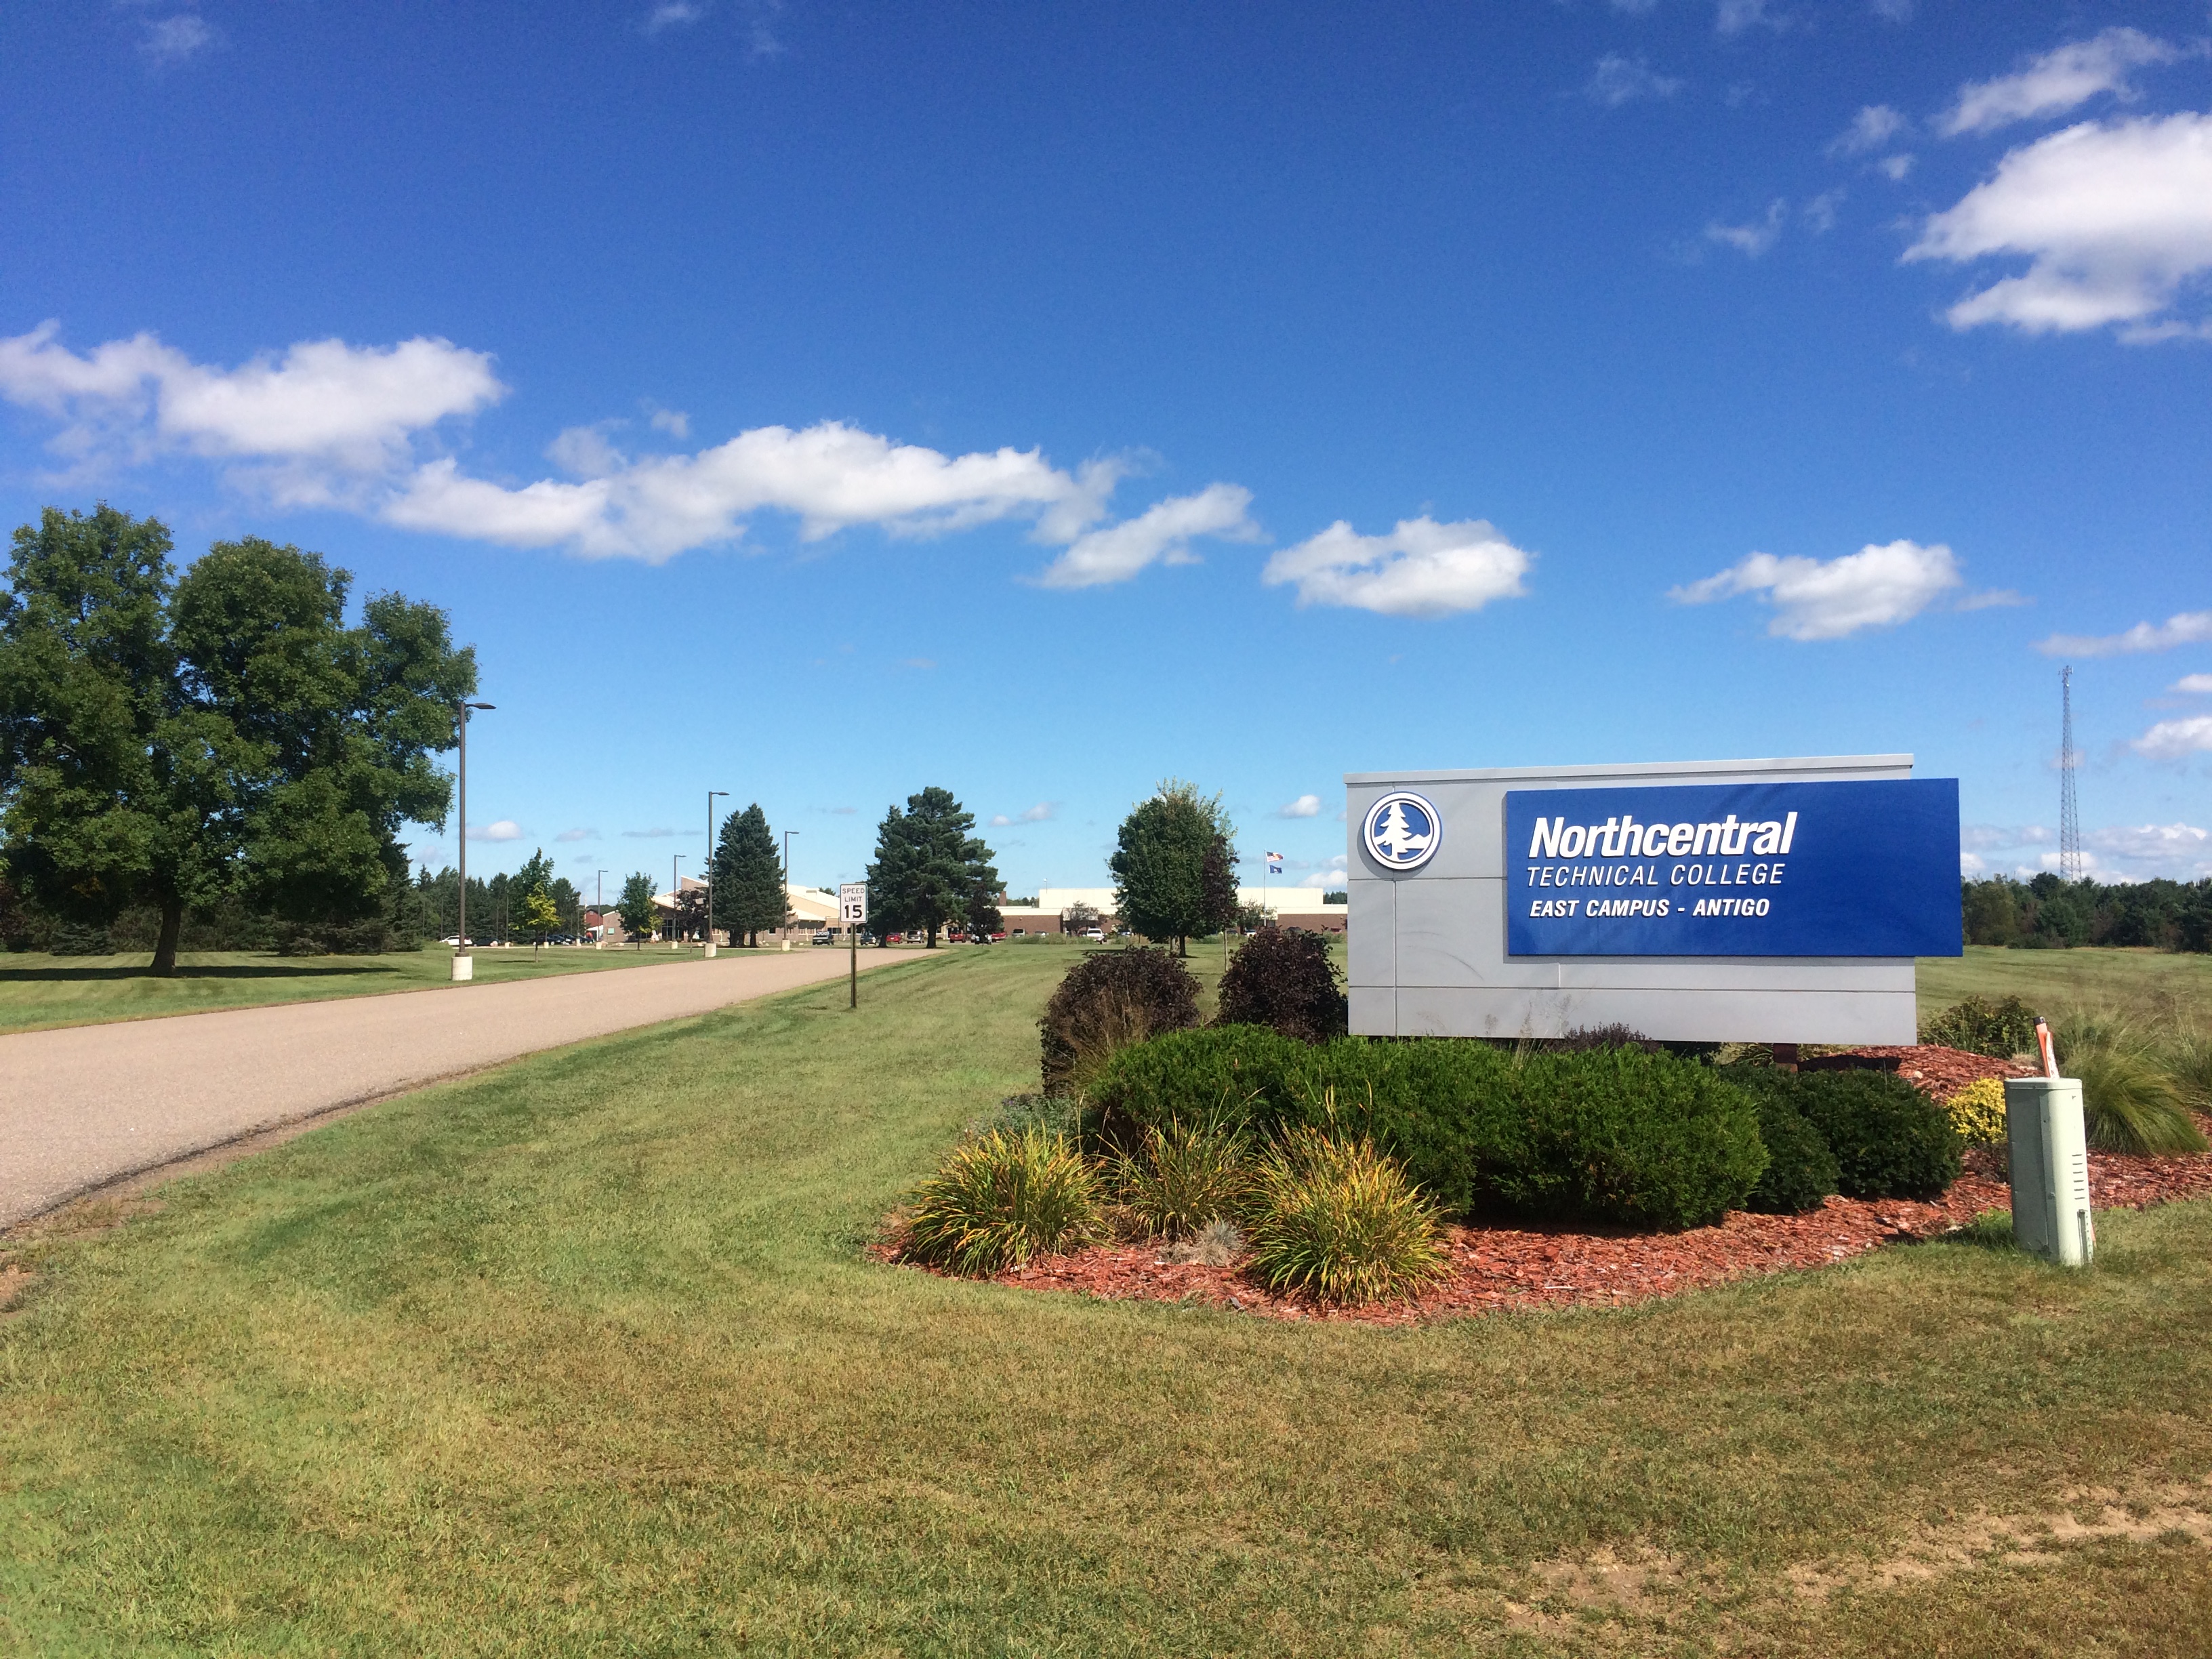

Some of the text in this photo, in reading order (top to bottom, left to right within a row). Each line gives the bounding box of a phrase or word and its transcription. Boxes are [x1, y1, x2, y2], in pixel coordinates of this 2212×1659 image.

[1528, 811, 1798, 859] Northcentral
[1527, 863, 1786, 888] TECHNICAL COLLEGE
[844, 905, 863, 918] 15
[1530, 899, 1580, 918] EAST
[1586, 899, 1670, 917] CAMPUS
[1692, 898, 1770, 917] ANTIGO
